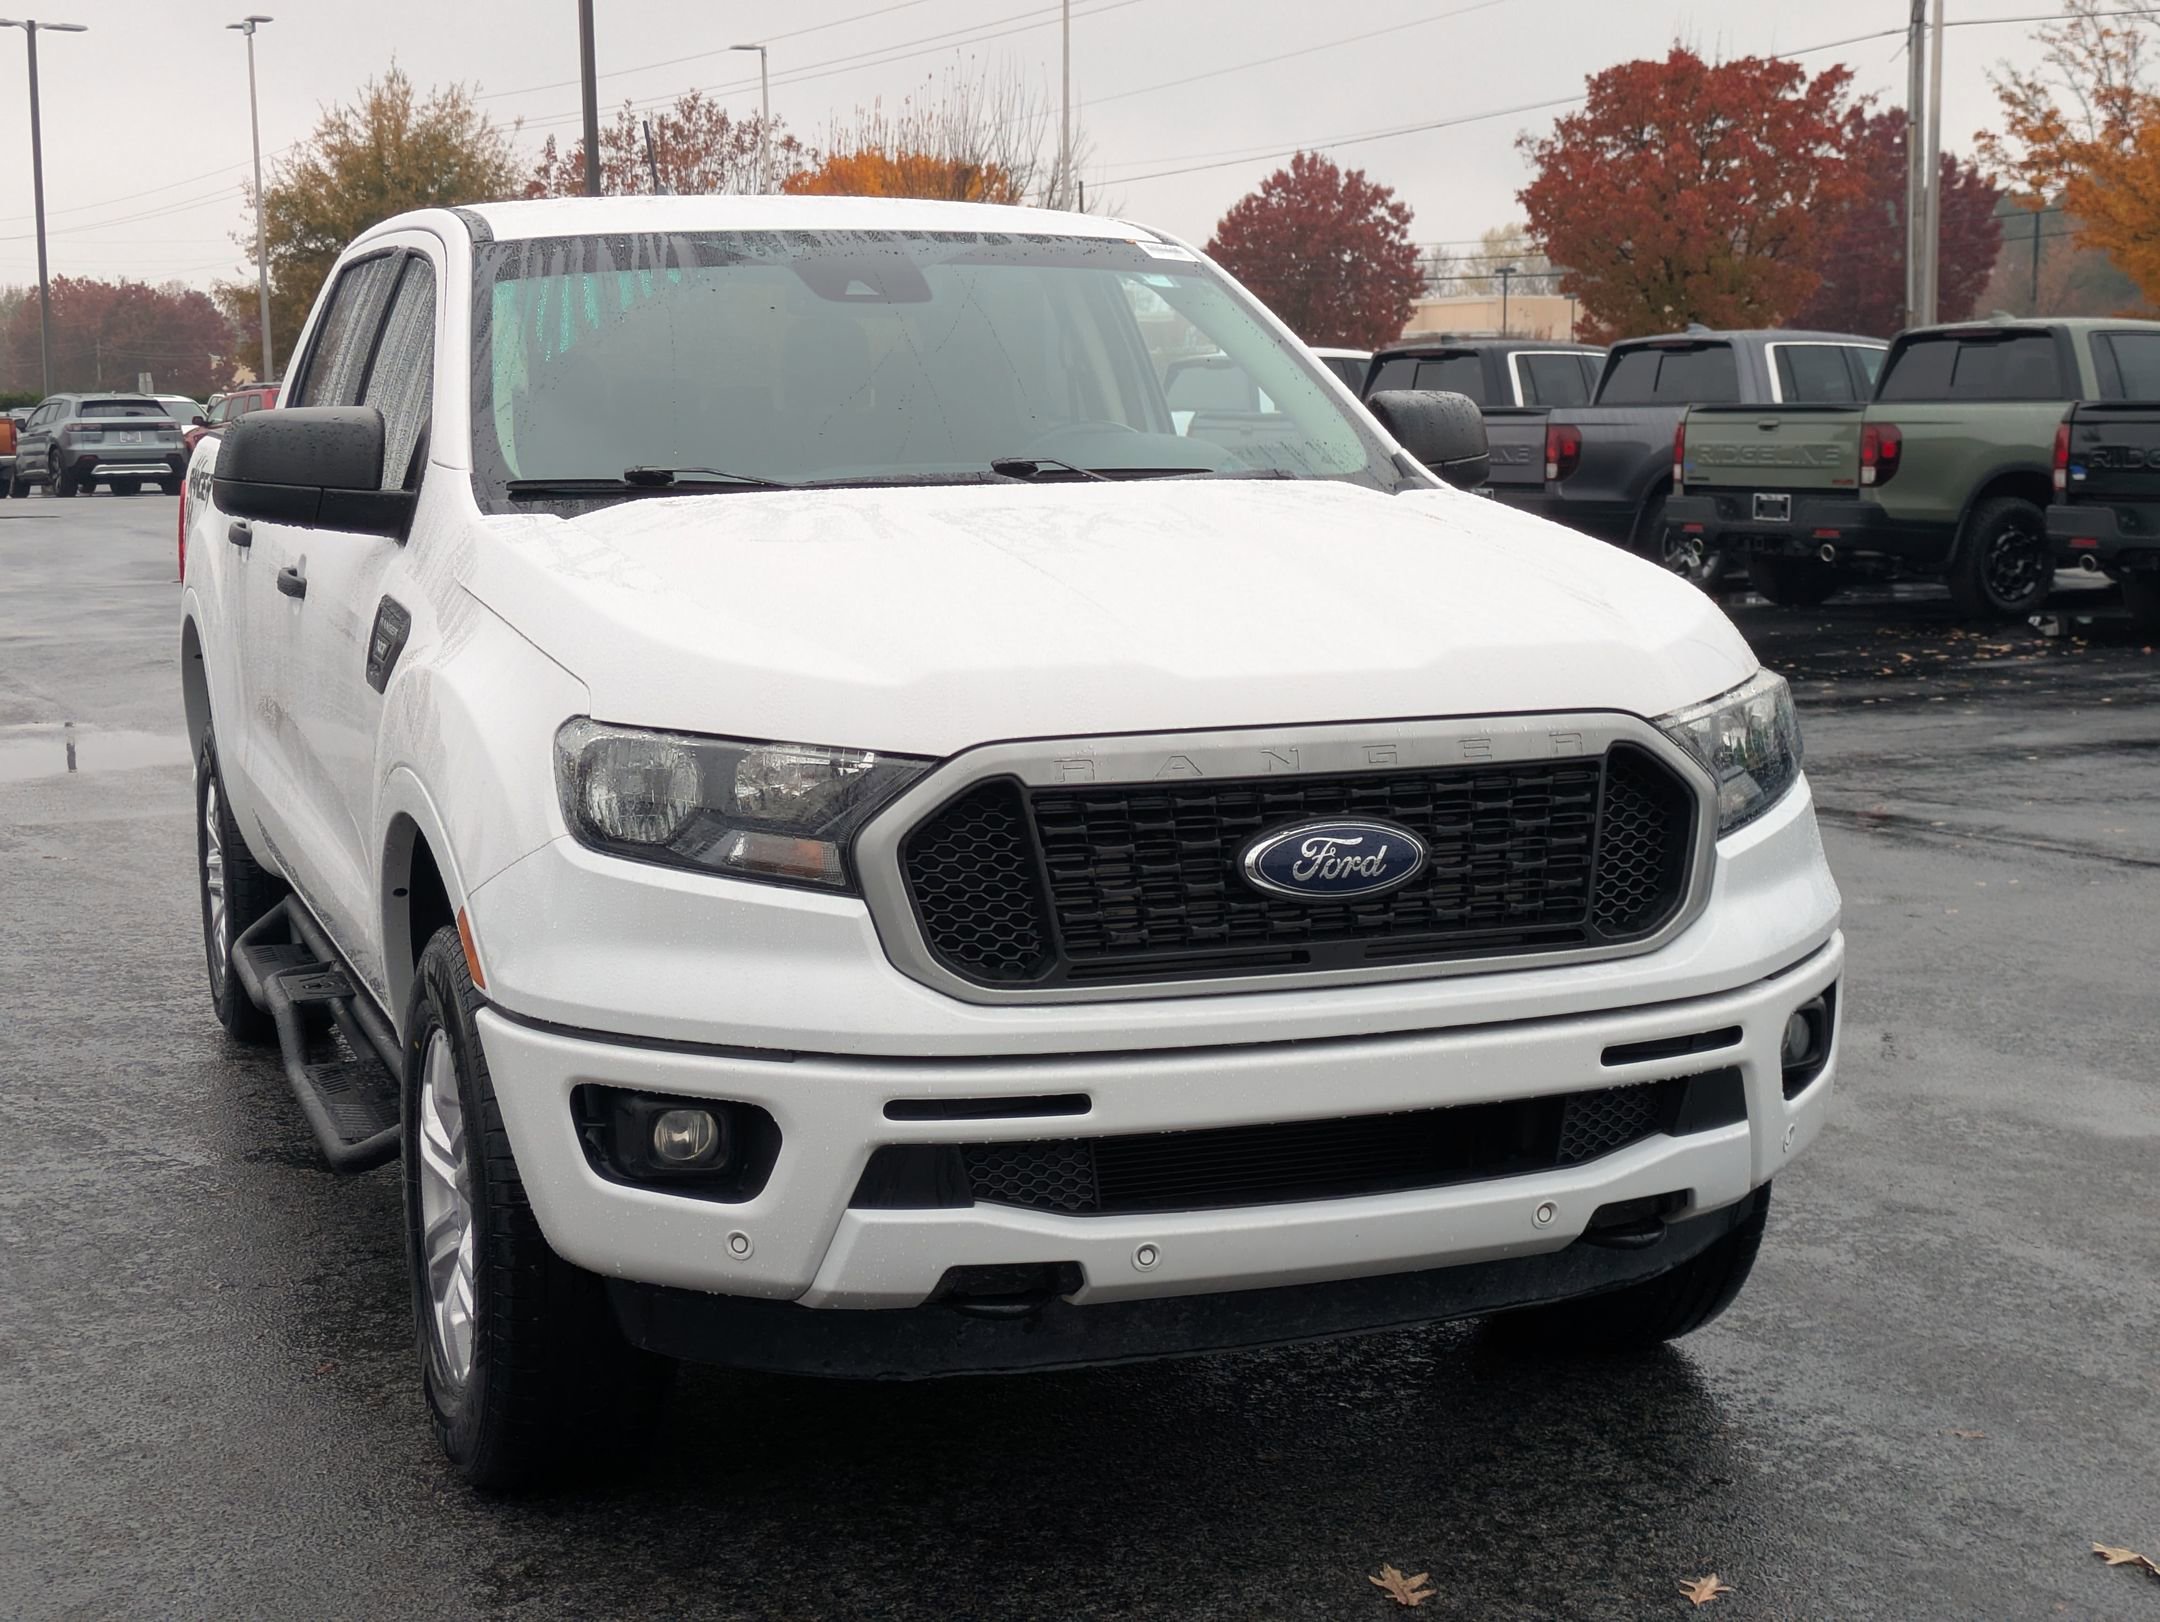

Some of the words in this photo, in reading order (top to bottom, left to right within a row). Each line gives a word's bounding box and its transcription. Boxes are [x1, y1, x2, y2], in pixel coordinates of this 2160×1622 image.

[1697, 446, 1841, 465] RIDGELINE
[1053, 732, 1583, 784] RANGER
[1292, 836, 1388, 881] Ford
